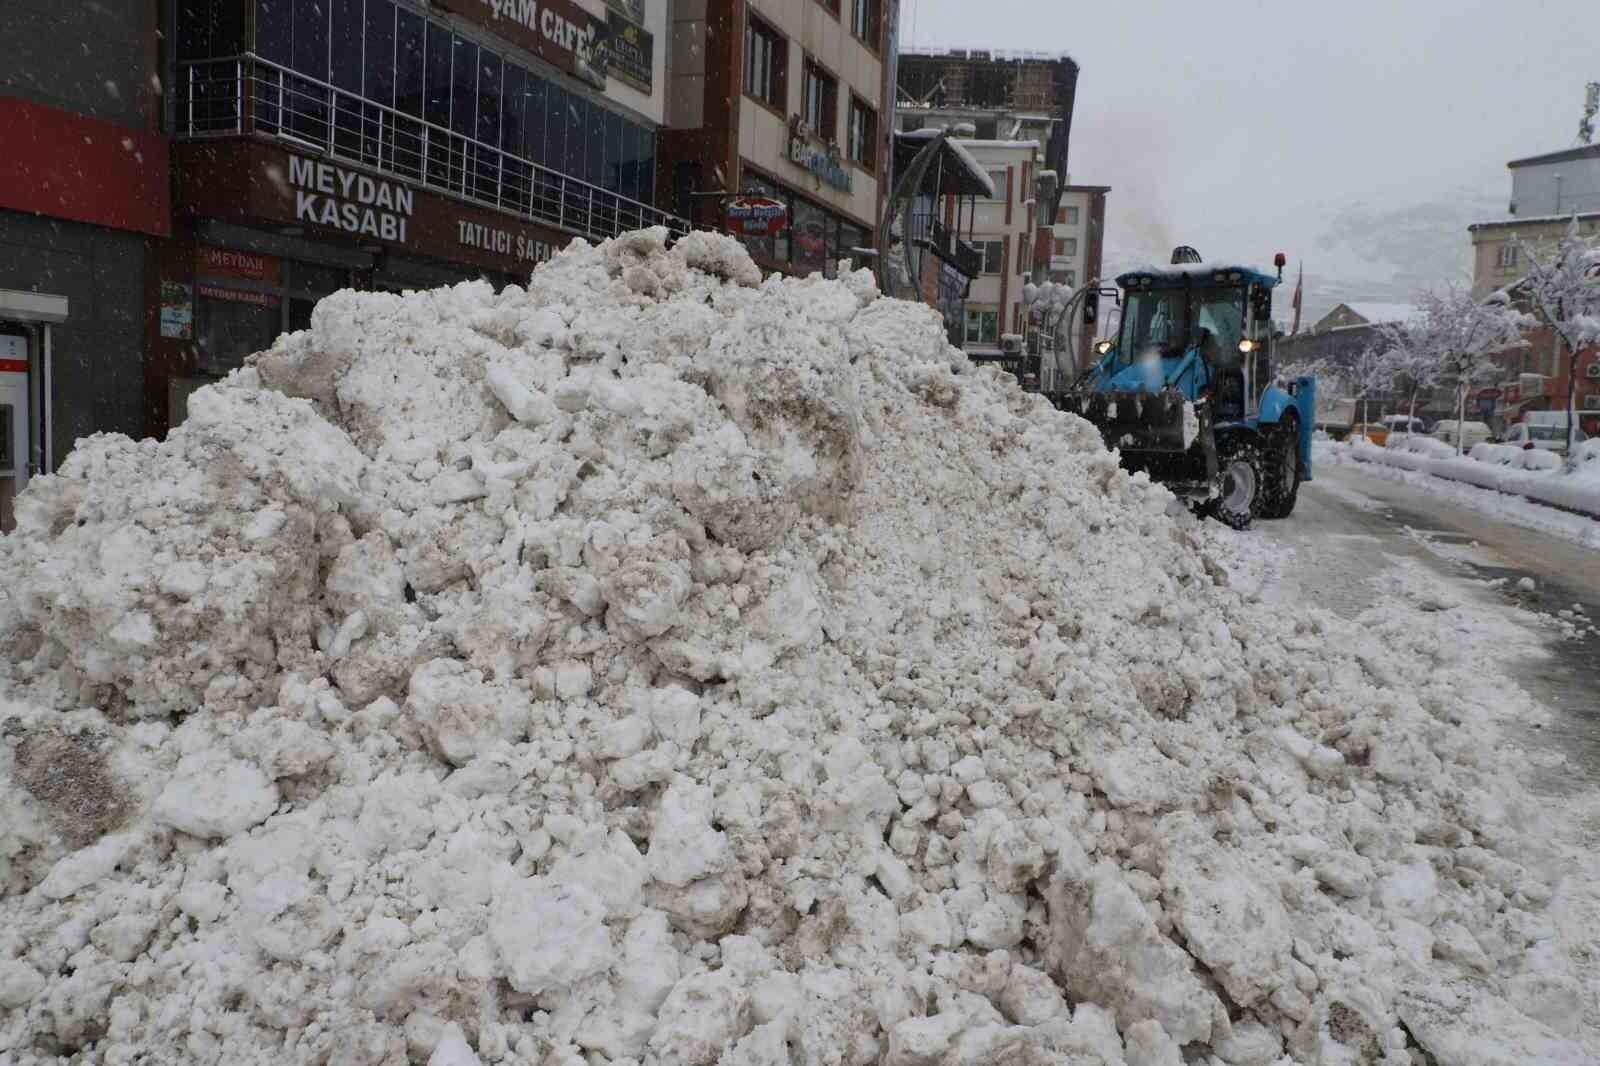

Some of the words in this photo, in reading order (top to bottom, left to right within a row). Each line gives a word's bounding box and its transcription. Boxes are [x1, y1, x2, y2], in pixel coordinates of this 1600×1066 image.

[288, 154, 413, 216] MEYDAN
[295, 190, 407, 243] KASABI
[457, 219, 511, 255] TATLICI
